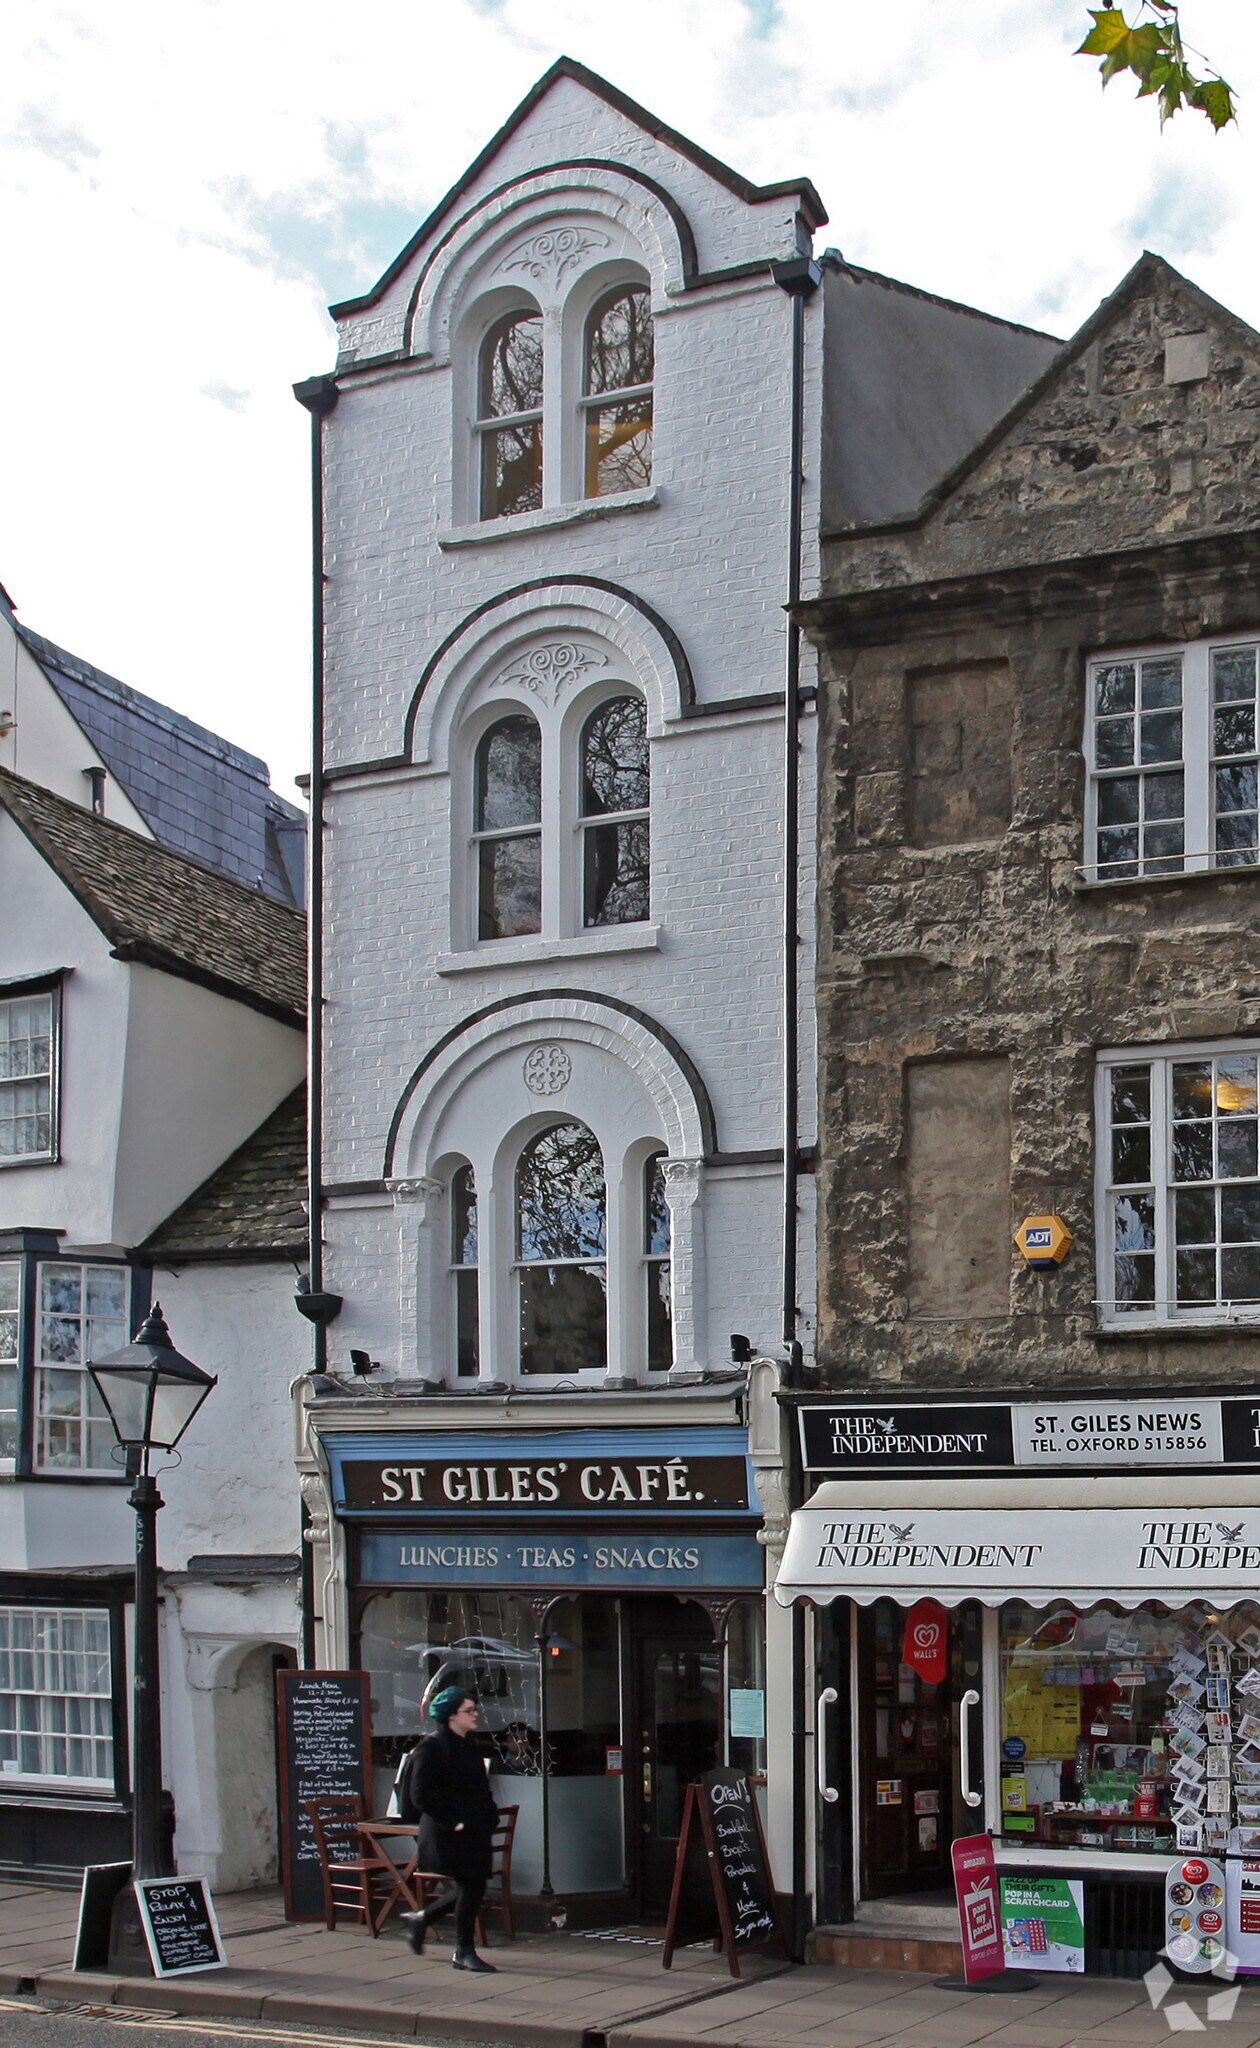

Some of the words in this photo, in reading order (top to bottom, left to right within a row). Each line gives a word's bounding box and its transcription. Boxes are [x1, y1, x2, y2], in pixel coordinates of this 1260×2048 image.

[1026, 1231, 1051, 1243] ADT
[829, 1417, 876, 1436] THE
[1034, 1416, 1065, 1433] ST.
[1070, 1414, 1131, 1433] GILES
[1138, 1413, 1202, 1432] NEWS
[831, 1434, 988, 1454] INDEPENDENT
[1030, 1439, 1062, 1452] TEL.
[1066, 1437, 1139, 1451] OXFORD
[1144, 1436, 1207, 1450] 515856
[381, 1467, 427, 1502] ST
[580, 1456, 705, 1501] CAFÉ.
[822, 1522, 886, 1545] THE
[1142, 1522, 1213, 1545] THE
[400, 1546, 499, 1567] LUNCHES
[516, 1547, 576, 1567] TEAS
[595, 1547, 700, 1569] SNACKS
[815, 1545, 1043, 1568] INDEPENDENT
[963, 1856, 986, 1869] amazon
[1004, 1890, 1022, 1898] POP
[1023, 1891, 1033, 1899] IN
[1032, 1891, 1041, 1899] A
[1031, 1885, 1056, 1893] GIFTS
[149, 1901, 185, 1913] RELAX
[972, 1903, 987, 1918] pass
[1004, 1898, 1070, 1908] SCRATCHCARD
[976, 1914, 986, 1924] my
[972, 1919, 993, 1940] parcel
